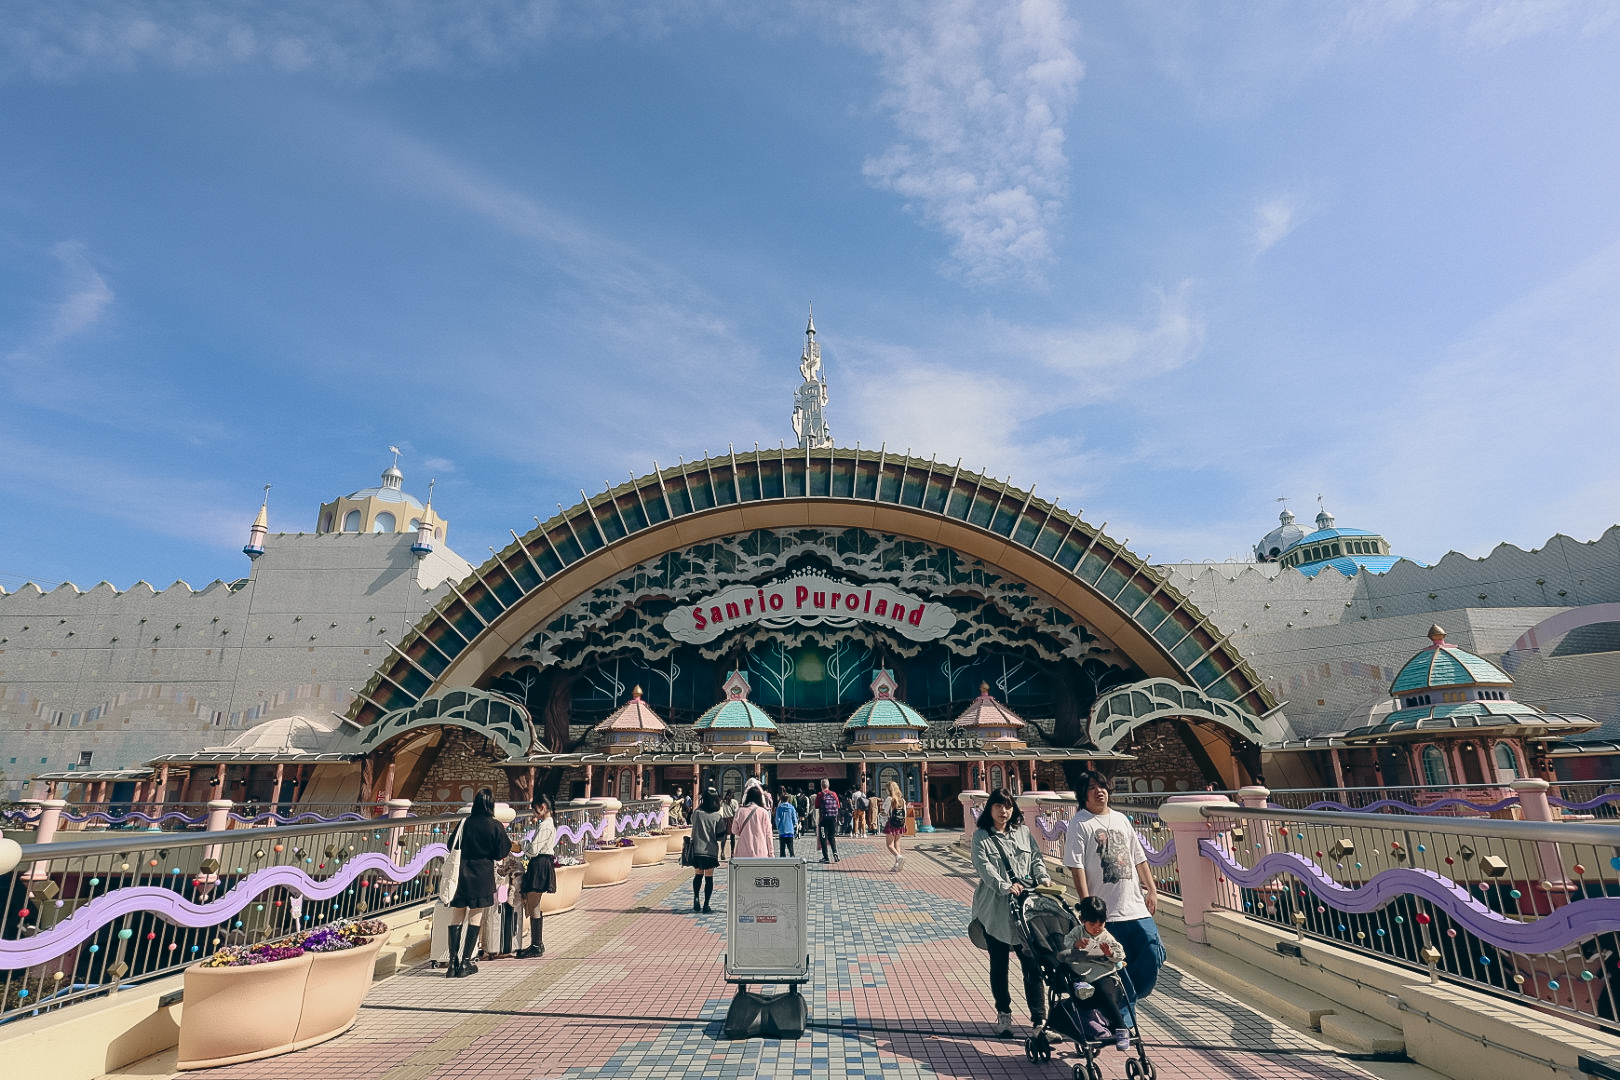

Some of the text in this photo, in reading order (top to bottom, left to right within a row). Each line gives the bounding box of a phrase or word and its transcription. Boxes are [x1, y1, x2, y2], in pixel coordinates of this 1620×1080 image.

[692, 586, 925, 630] Sanrio Puroland
[921, 738, 985, 749] TICKETS
